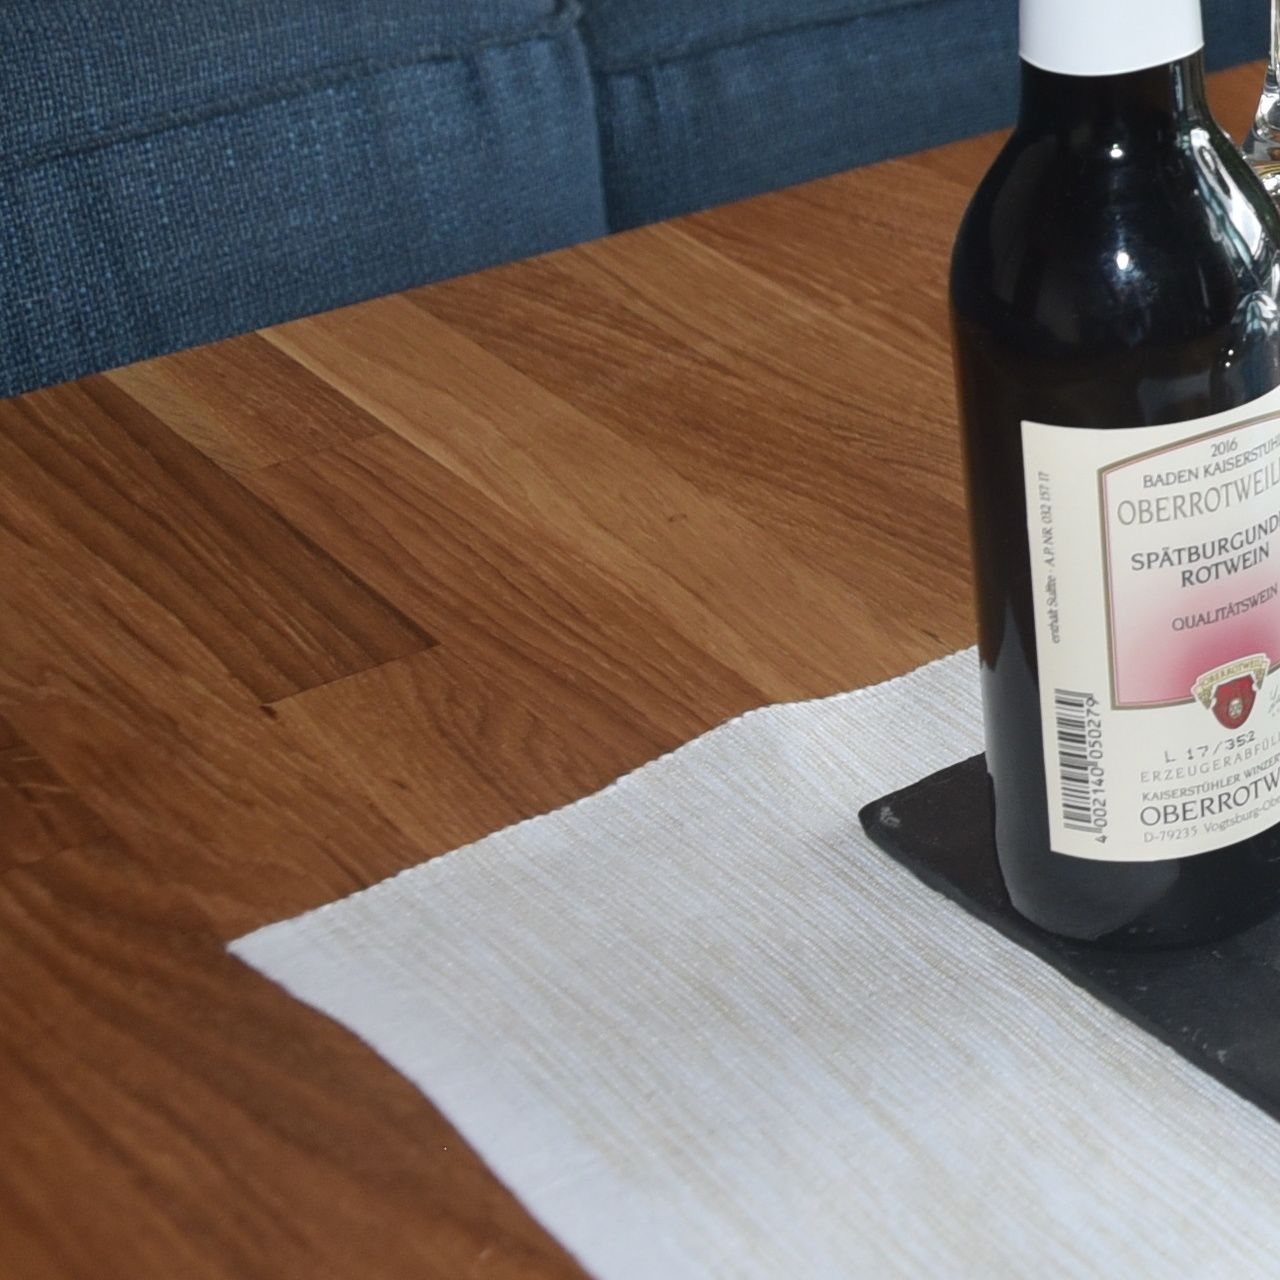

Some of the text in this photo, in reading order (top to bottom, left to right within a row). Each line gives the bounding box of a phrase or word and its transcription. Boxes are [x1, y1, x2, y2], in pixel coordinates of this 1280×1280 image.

[1211, 437, 1238, 458] 2016
[1143, 467, 1199, 488] BADEN
[1181, 542, 1270, 588] ROTWEIN
[1172, 582, 1278, 631] QUALITÄTSWEIN
[1142, 774, 1240, 802] KAISERSTÜHLER
[1143, 825, 1198, 843] D-79235
